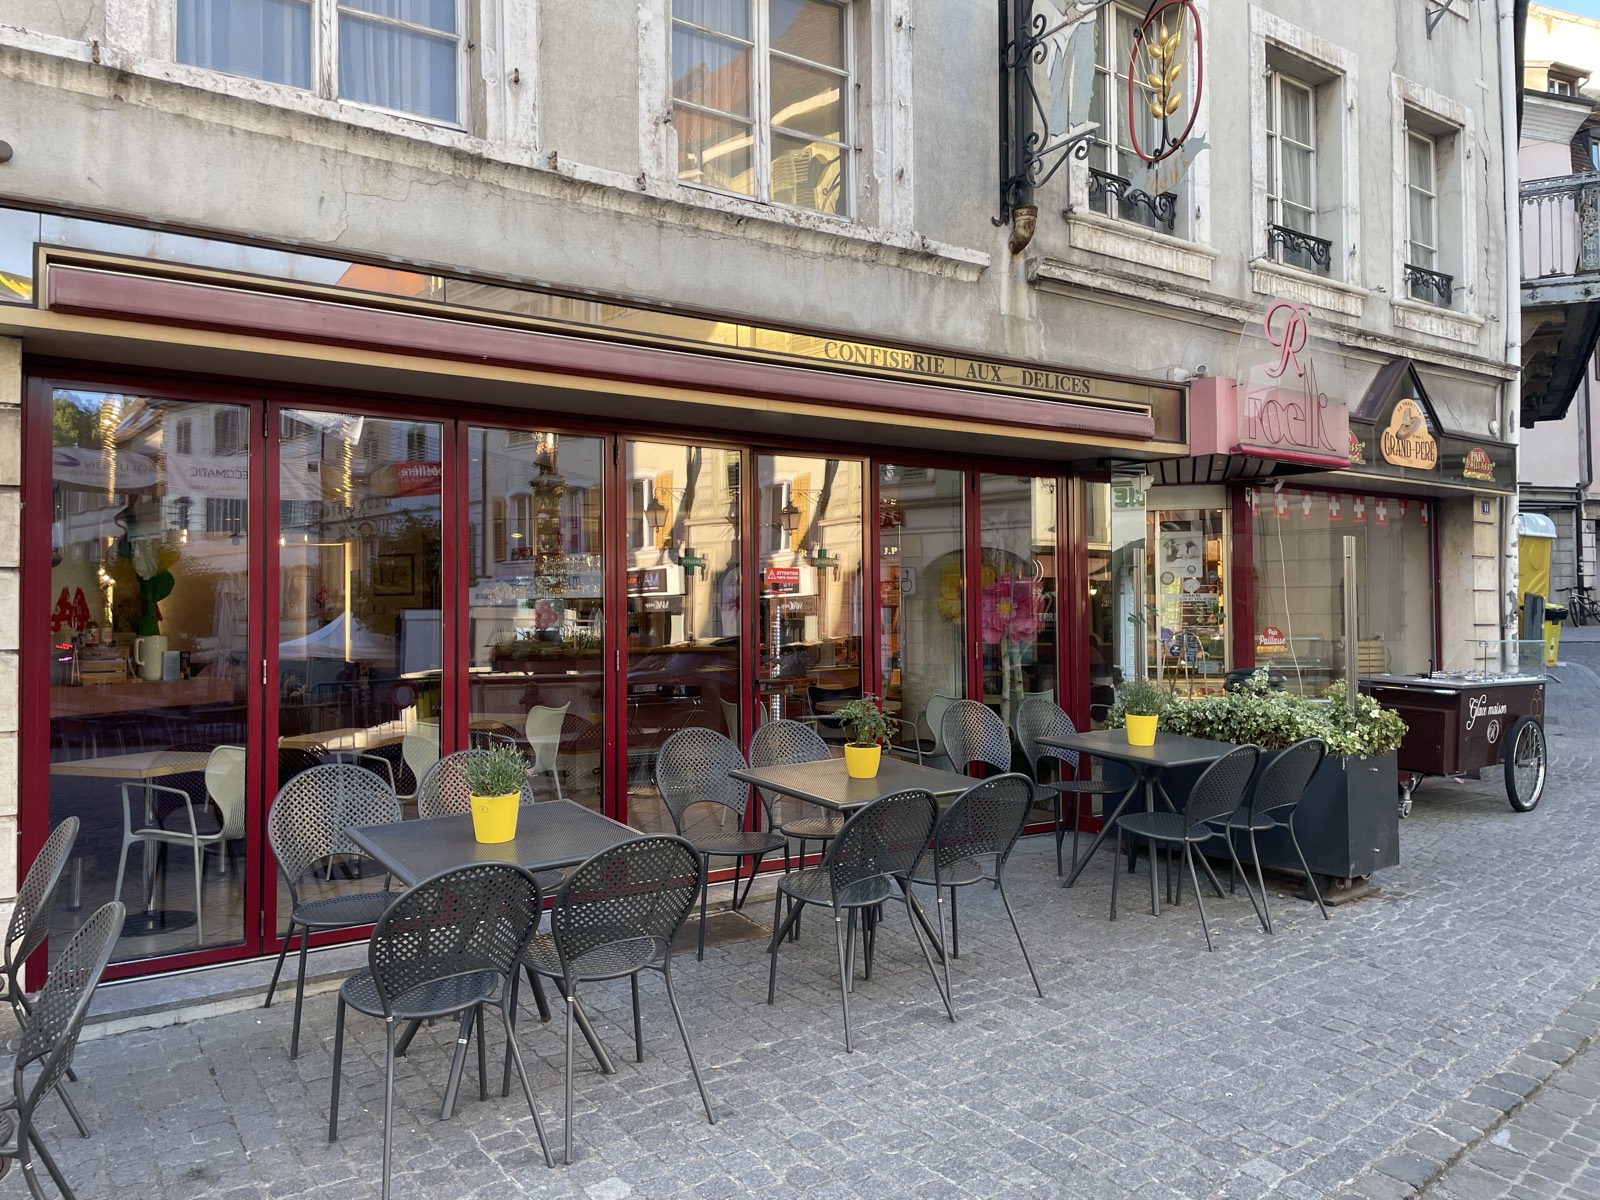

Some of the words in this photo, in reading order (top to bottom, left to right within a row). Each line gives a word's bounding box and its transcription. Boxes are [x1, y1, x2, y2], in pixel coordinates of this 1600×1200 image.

[824, 341, 945, 375] CONFISERIE
[965, 362, 1002, 383] AUX
[1021, 369, 1091, 394] DELICES
[1466, 694, 1487, 730] Glace
[1487, 702, 1507, 715] maison
